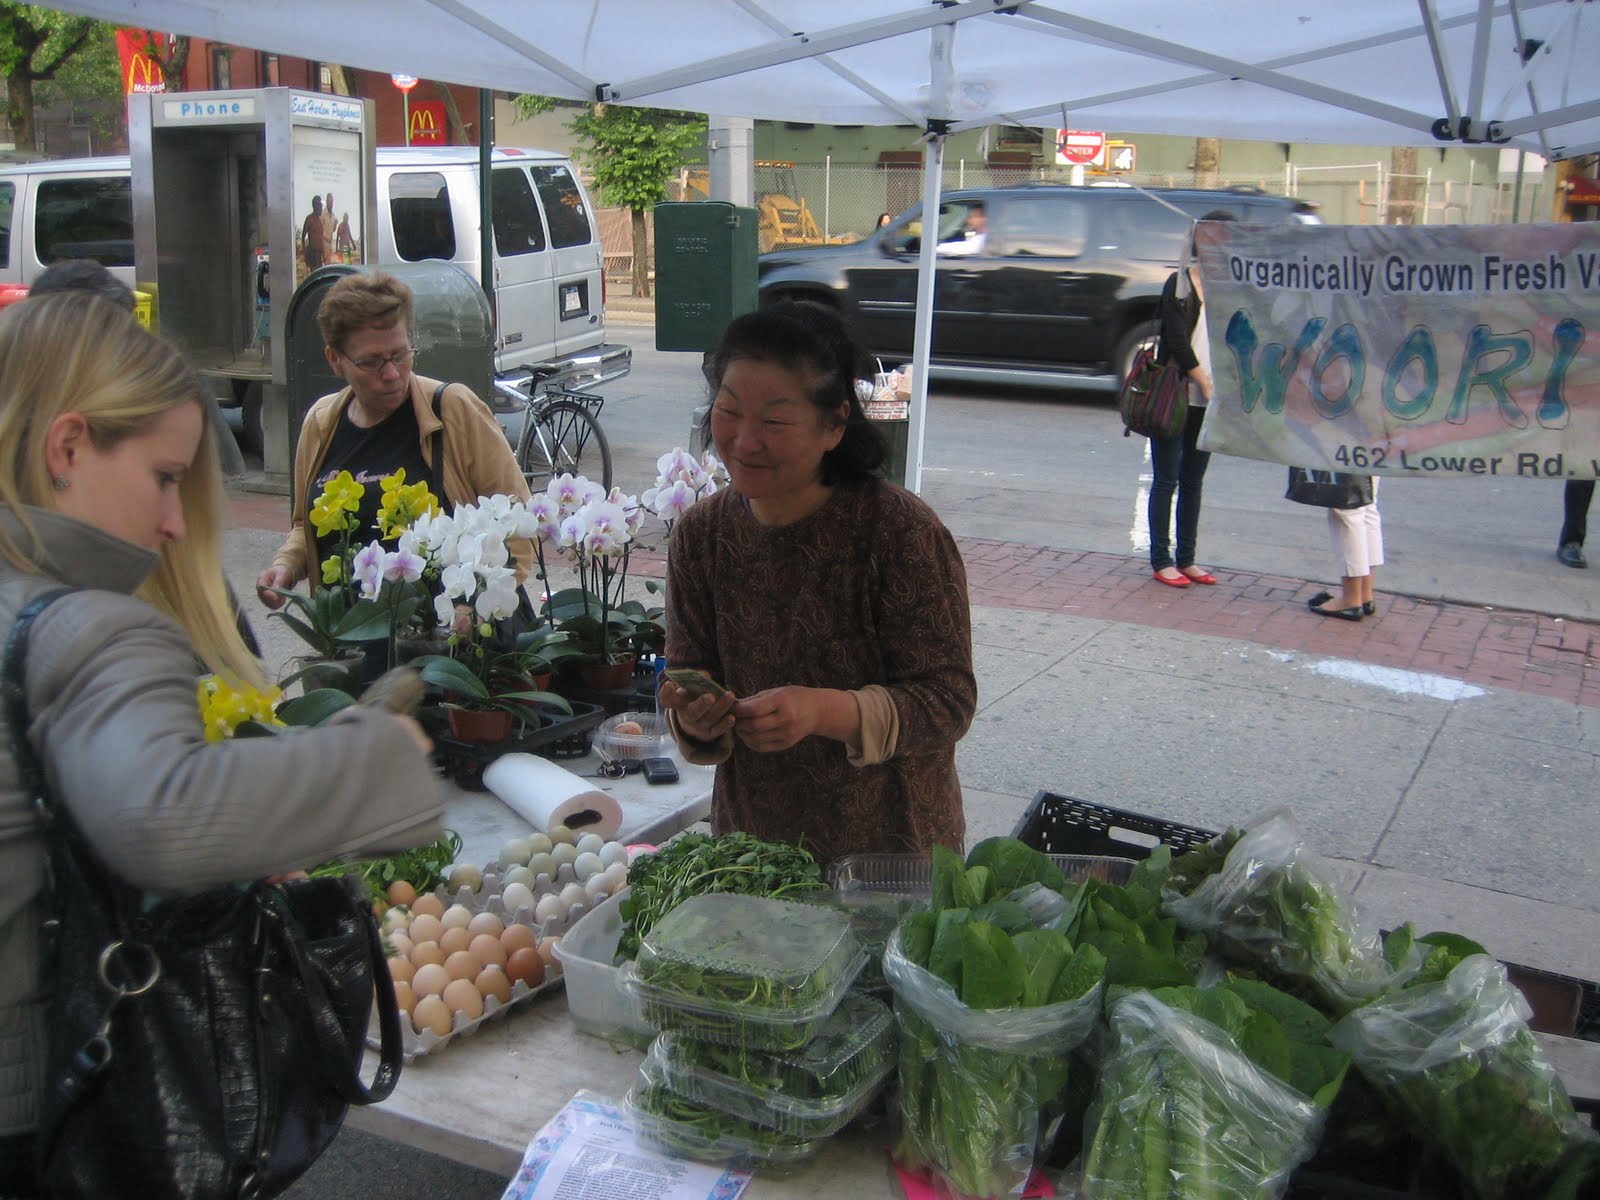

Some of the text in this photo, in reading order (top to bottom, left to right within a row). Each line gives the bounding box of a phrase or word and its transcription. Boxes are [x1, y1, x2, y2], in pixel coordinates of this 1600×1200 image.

[181, 102, 241, 116] Phone
[292, 97, 360, 119] East Harlem Payphones
[1386, 255, 1473, 293] Grown
[1484, 253, 1566, 290] Fresh
[1576, 253, 1600, 289] V
[1225, 308, 1585, 430] WOORI
[1335, 445, 1389, 469] 462
[1401, 449, 1502, 475] Lower
[1518, 452, 1576, 477] Rd.
